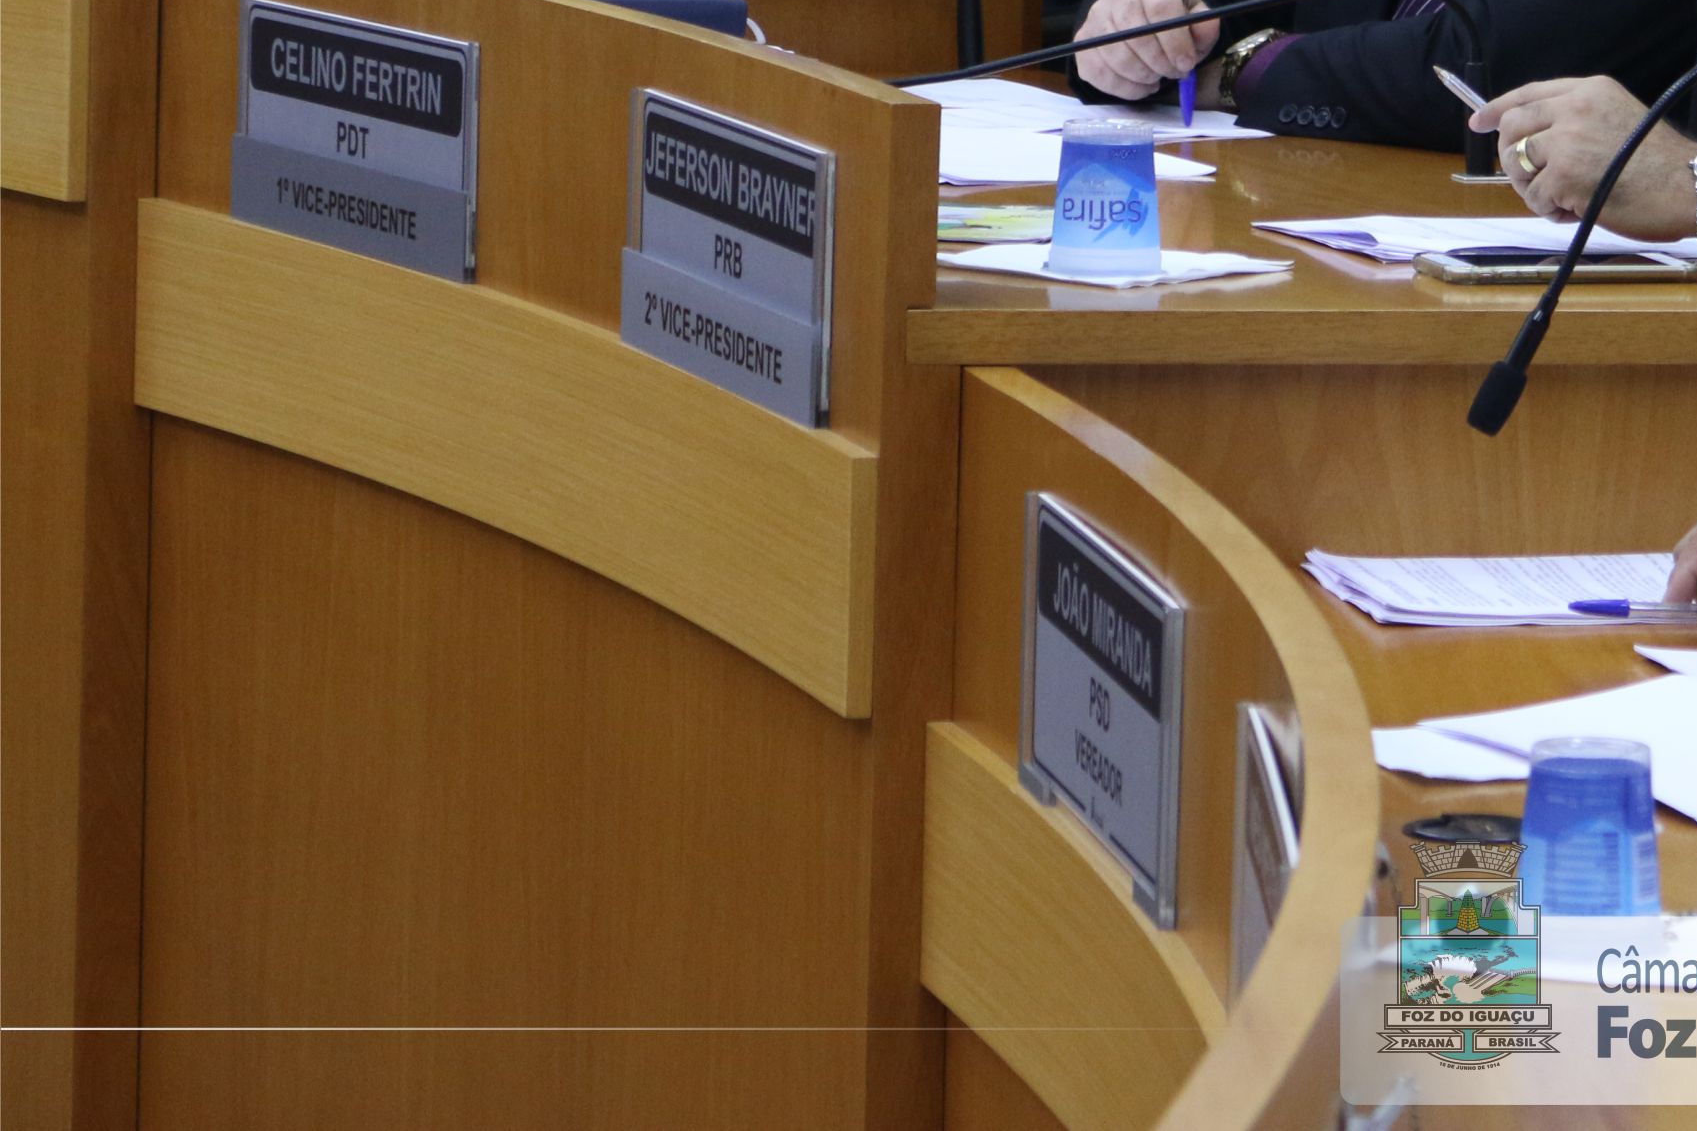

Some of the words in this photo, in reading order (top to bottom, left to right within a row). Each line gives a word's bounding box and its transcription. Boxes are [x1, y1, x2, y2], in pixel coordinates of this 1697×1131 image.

[270, 37, 346, 92] CELINO
[353, 56, 442, 116] FERTRIN
[336, 121, 370, 159] PDT
[646, 131, 733, 206] JEFERSON
[293, 181, 417, 241] VICE-PRESIDENTE
[1062, 197, 1144, 231] safira
[714, 234, 743, 280] PRB
[659, 297, 783, 385] VICE-PRESIDENTE
[1053, 562, 1089, 637] JOÃO
[1091, 596, 1153, 699] MIRANDA
[1089, 677, 1110, 732] PSD
[1073, 728, 1123, 807] VEREADOR
